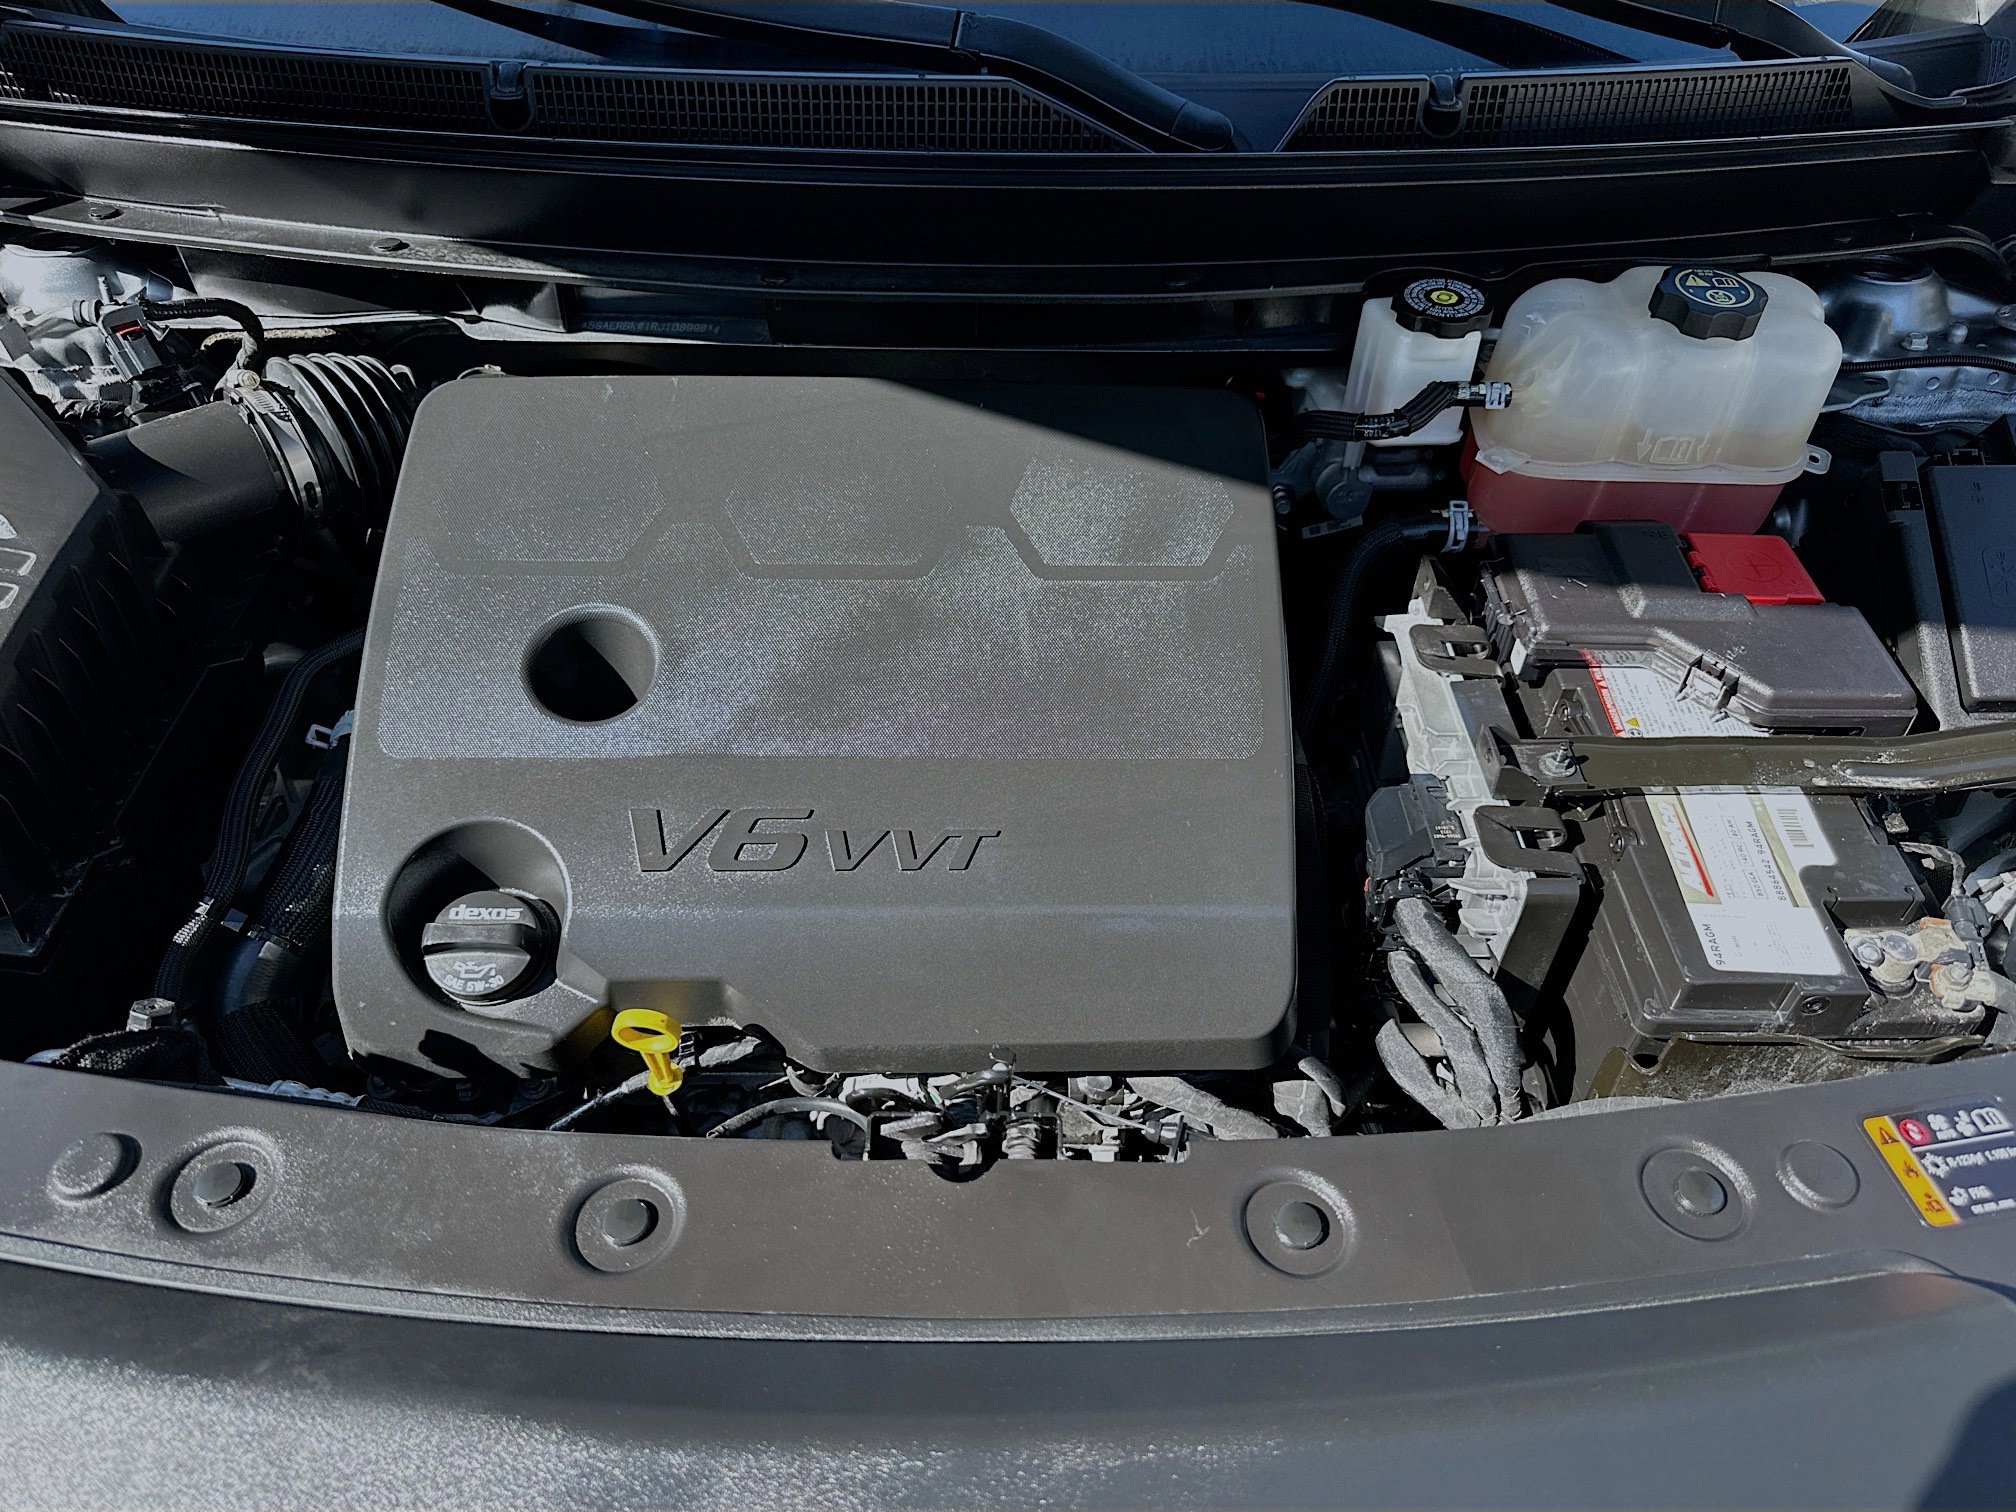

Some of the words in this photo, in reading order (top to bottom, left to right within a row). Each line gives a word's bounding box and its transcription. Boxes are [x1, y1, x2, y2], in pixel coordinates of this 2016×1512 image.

[629, 808, 815, 872] V6
[825, 829, 1001, 871] VVT
[1745, 821, 1766, 855] 94RAGM
[1761, 859, 1787, 901] 88864542
[448, 904, 524, 920] dexos
[1701, 923, 1727, 966] 94RAGM
[442, 974, 466, 991] SAE
[465, 974, 505, 992] 5W-30
